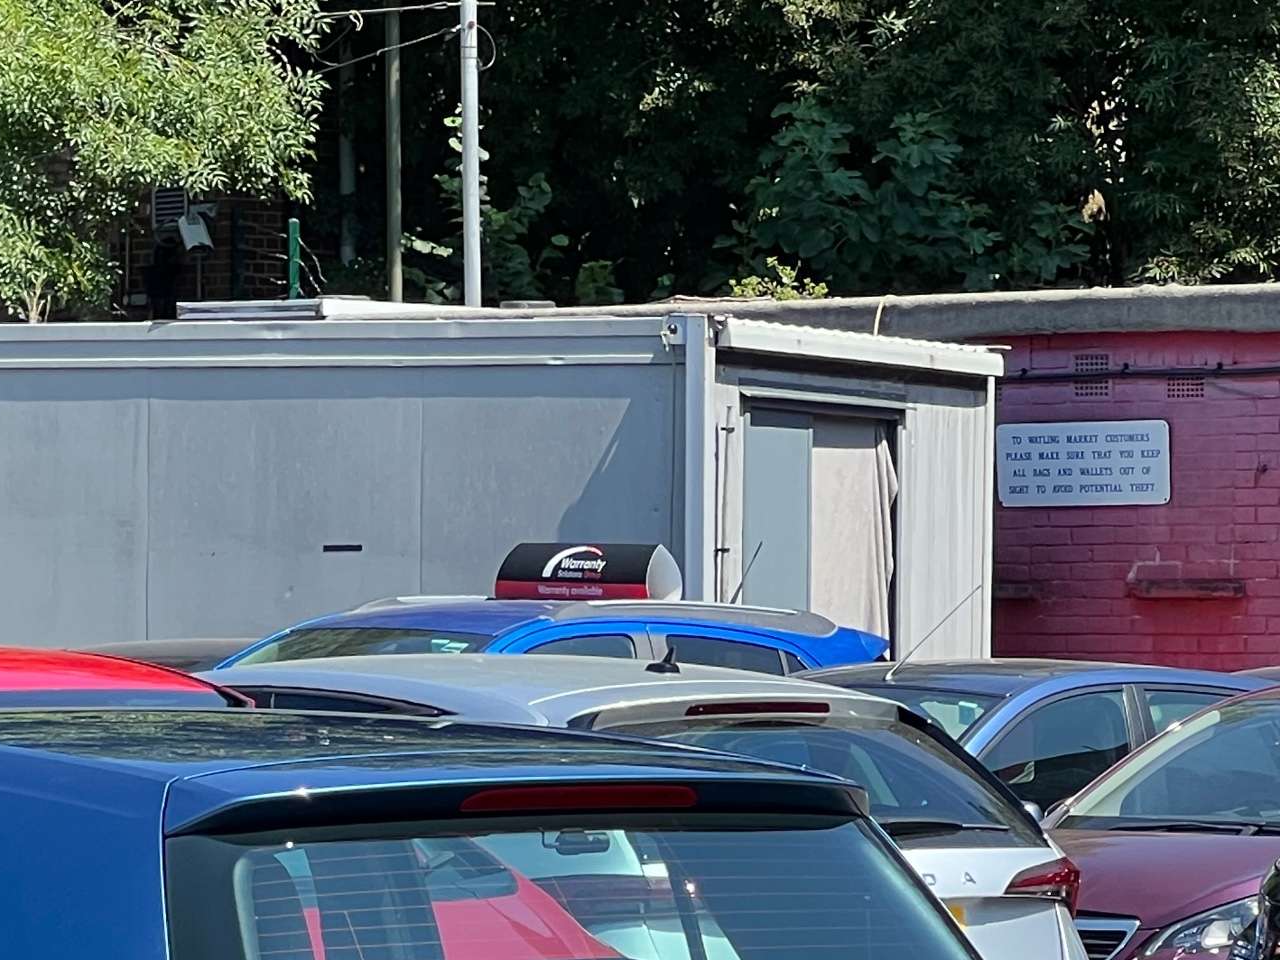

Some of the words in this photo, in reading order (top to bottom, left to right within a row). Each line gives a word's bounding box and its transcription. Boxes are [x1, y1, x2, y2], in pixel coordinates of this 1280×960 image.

[1011, 435, 1022, 445] TO
[1066, 434, 1099, 444] MARKET
[1105, 433, 1150, 443] CUSTOMERS
[1006, 451, 1033, 461] PLEASE
[1038, 451, 1060, 461] MAKE
[1066, 451, 1085, 460] SURE
[1091, 450, 1112, 460] THAT
[1119, 450, 1134, 459] YOU
[1141, 449, 1161, 458] KEEP
[1013, 468, 1026, 478] ALL
[1057, 468, 1073, 477] AND
[1079, 467, 1113, 477] WALLETS
[1119, 466, 1135, 476] OUT
[1141, 465, 1151, 476] OF
[1008, 485, 1029, 494] SIGHT
[1036, 484, 1046, 494] TO
[1079, 483, 1123, 494] POTENTIAL
[561, 557, 607, 573] Warranty
